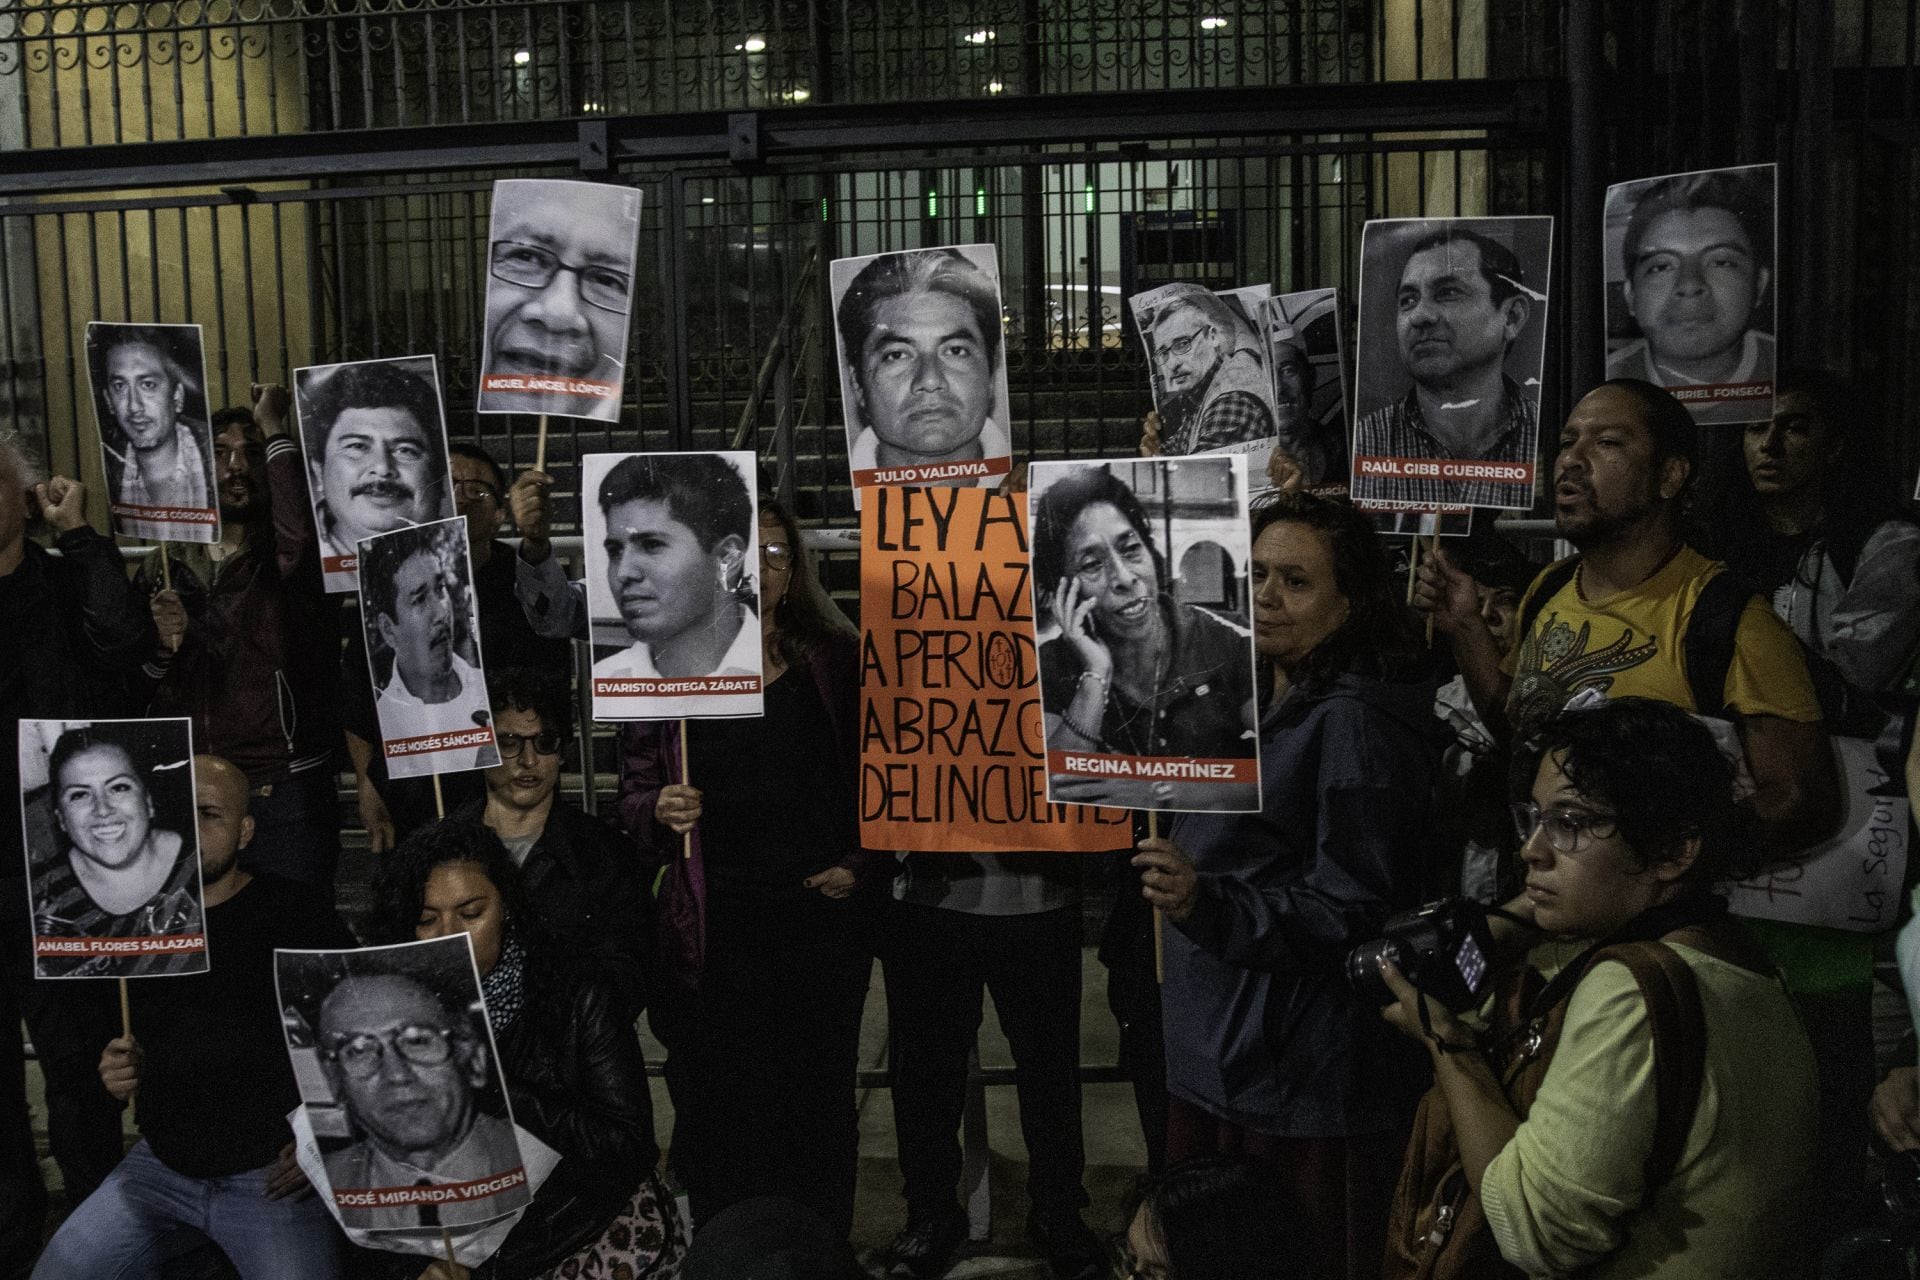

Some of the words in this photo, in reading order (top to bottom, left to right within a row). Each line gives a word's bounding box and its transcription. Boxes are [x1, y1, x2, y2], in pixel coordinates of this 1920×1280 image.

[487, 378, 527, 389] MIGUEL
[528, 377, 568, 391] ÁNGEL
[1713, 386, 1771, 397] FONSECA
[873, 469, 916, 482] JULIO
[919, 463, 989, 479] VALDIVIA
[1362, 459, 1401, 473] RAÚL
[1404, 463, 1440, 475] GIBB
[1443, 465, 1526, 479] GUERRERO
[877, 487, 960, 551] LEY
[891, 560, 1033, 621] BALAZ
[860, 629, 888, 687] A
[597, 682, 657, 693] EVARISTO
[657, 682, 707, 693] ORTEGA
[709, 679, 757, 691] ZÁRATE
[388, 741, 408, 754] JOSÉ
[408, 737, 441, 752] MOISÉS
[442, 732, 491, 747] SÁNCHEZ
[1065, 756, 1132, 774] REGINA
[1136, 760, 1235, 778] MARTÍNEZ
[861, 763, 1130, 824] DELINCUE
[38, 941, 89, 951] ANABEL
[91, 941, 140, 951] FLORES
[141, 938, 204, 950] SALAZAR
[336, 1191, 375, 1205] JOSÉ
[378, 1189, 458, 1204] MIRANDA
[460, 1171, 524, 1197] VIRGEN
